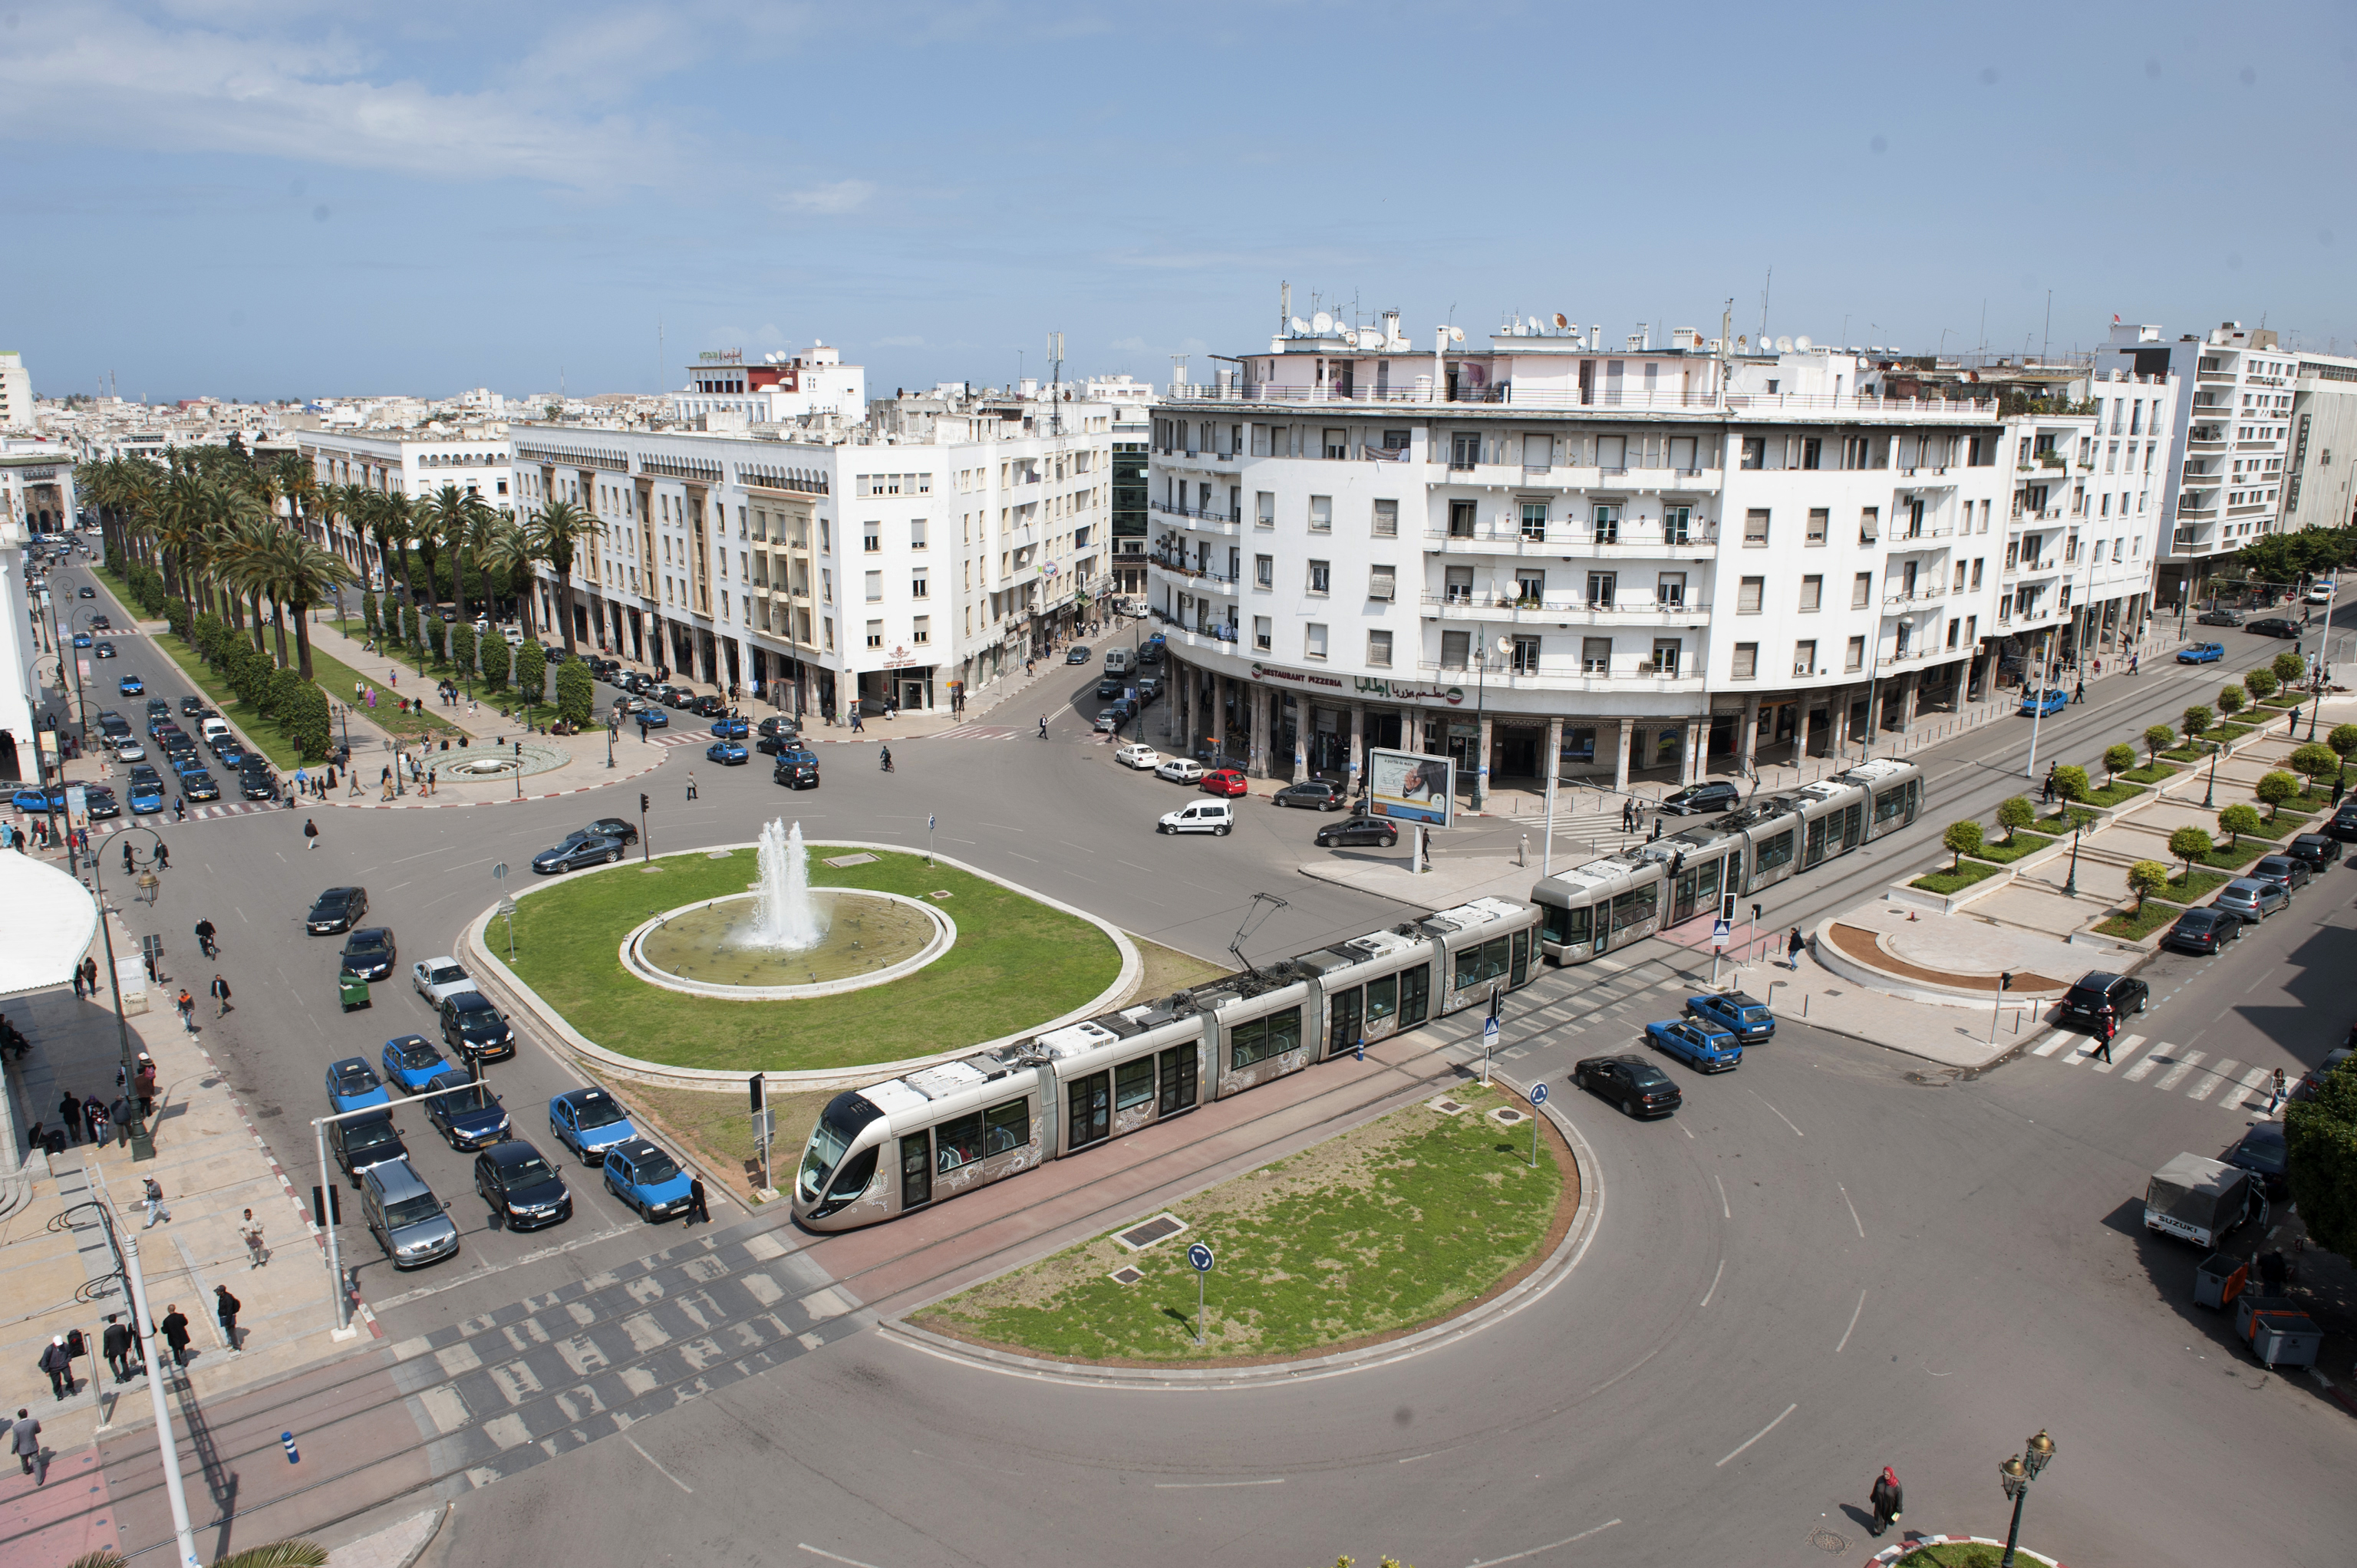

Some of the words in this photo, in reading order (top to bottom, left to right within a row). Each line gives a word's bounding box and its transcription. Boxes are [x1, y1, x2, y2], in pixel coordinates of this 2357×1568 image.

[697, 371, 740, 380] BALIMA
[1262, 668, 1305, 682] RESTAURANT
[1308, 676, 1343, 687] PIZZERIA
[1354, 676, 1391, 697] إيطاليا
[1416, 686, 1445, 700] مطعم
[2158, 1215, 2197, 1234] SUZUKI
